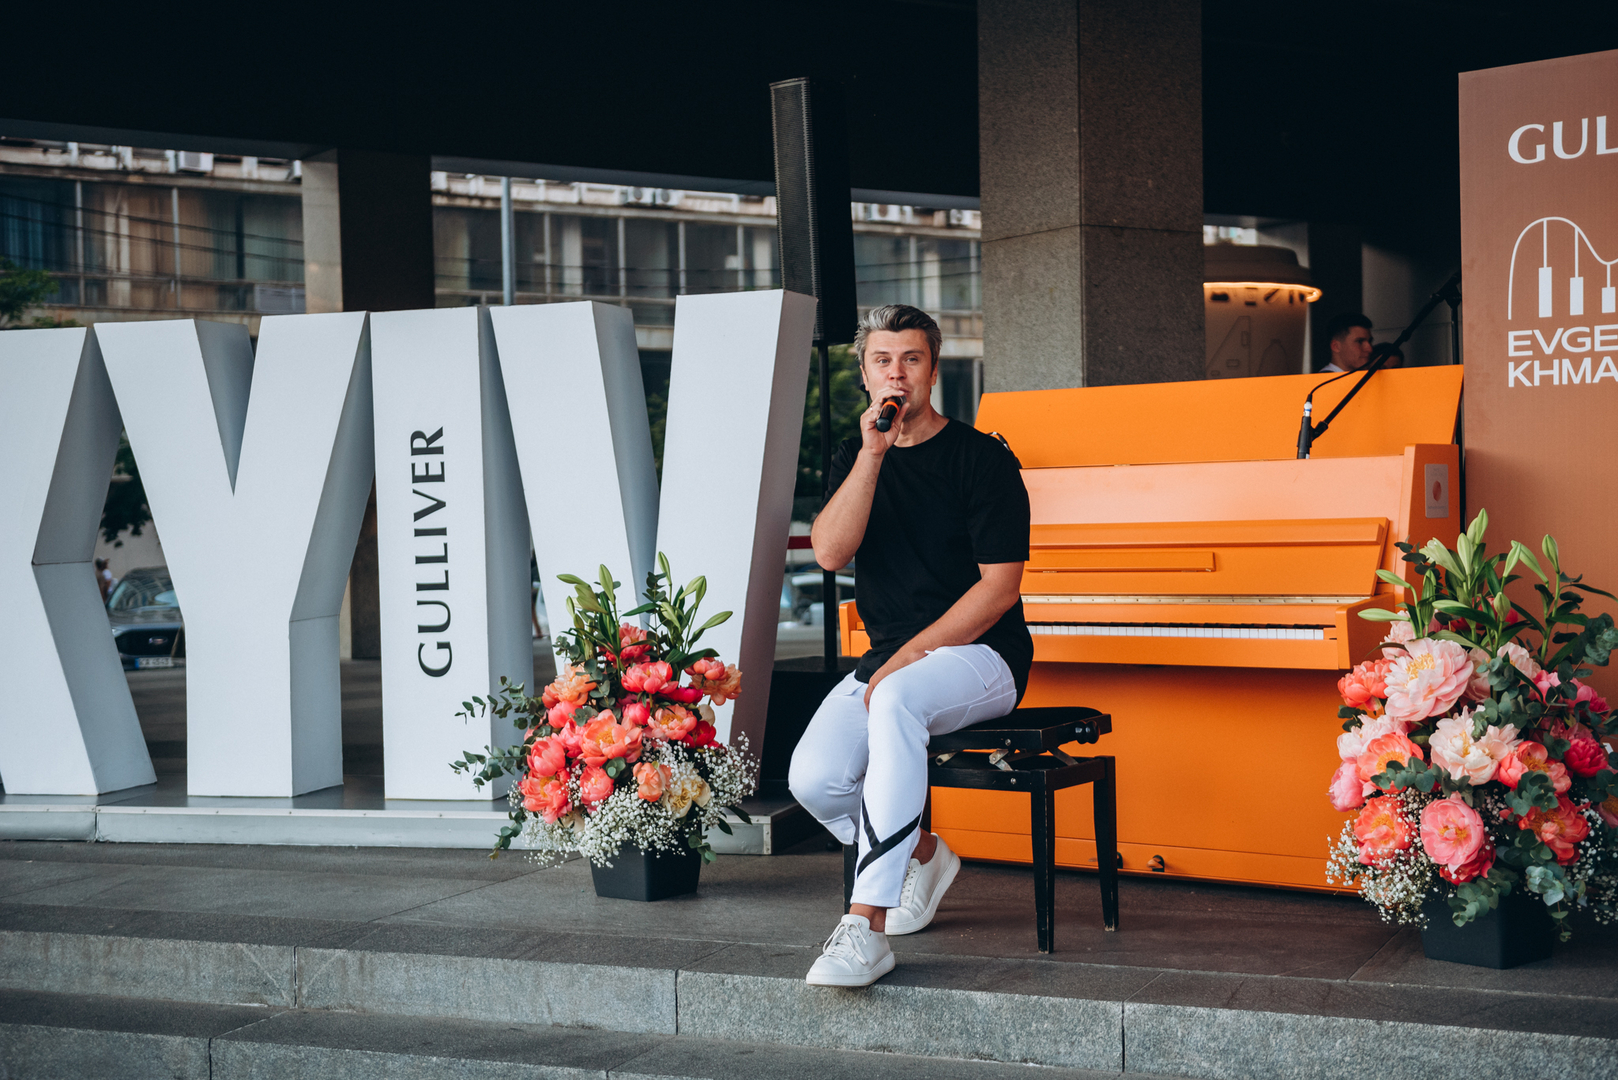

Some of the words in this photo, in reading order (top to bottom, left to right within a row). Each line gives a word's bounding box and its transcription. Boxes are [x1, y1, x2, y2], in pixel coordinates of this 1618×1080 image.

[1508, 324, 1618, 357] EVGE
[1508, 356, 1618, 387] KHMA
[410, 426, 453, 678] GULLIVER
